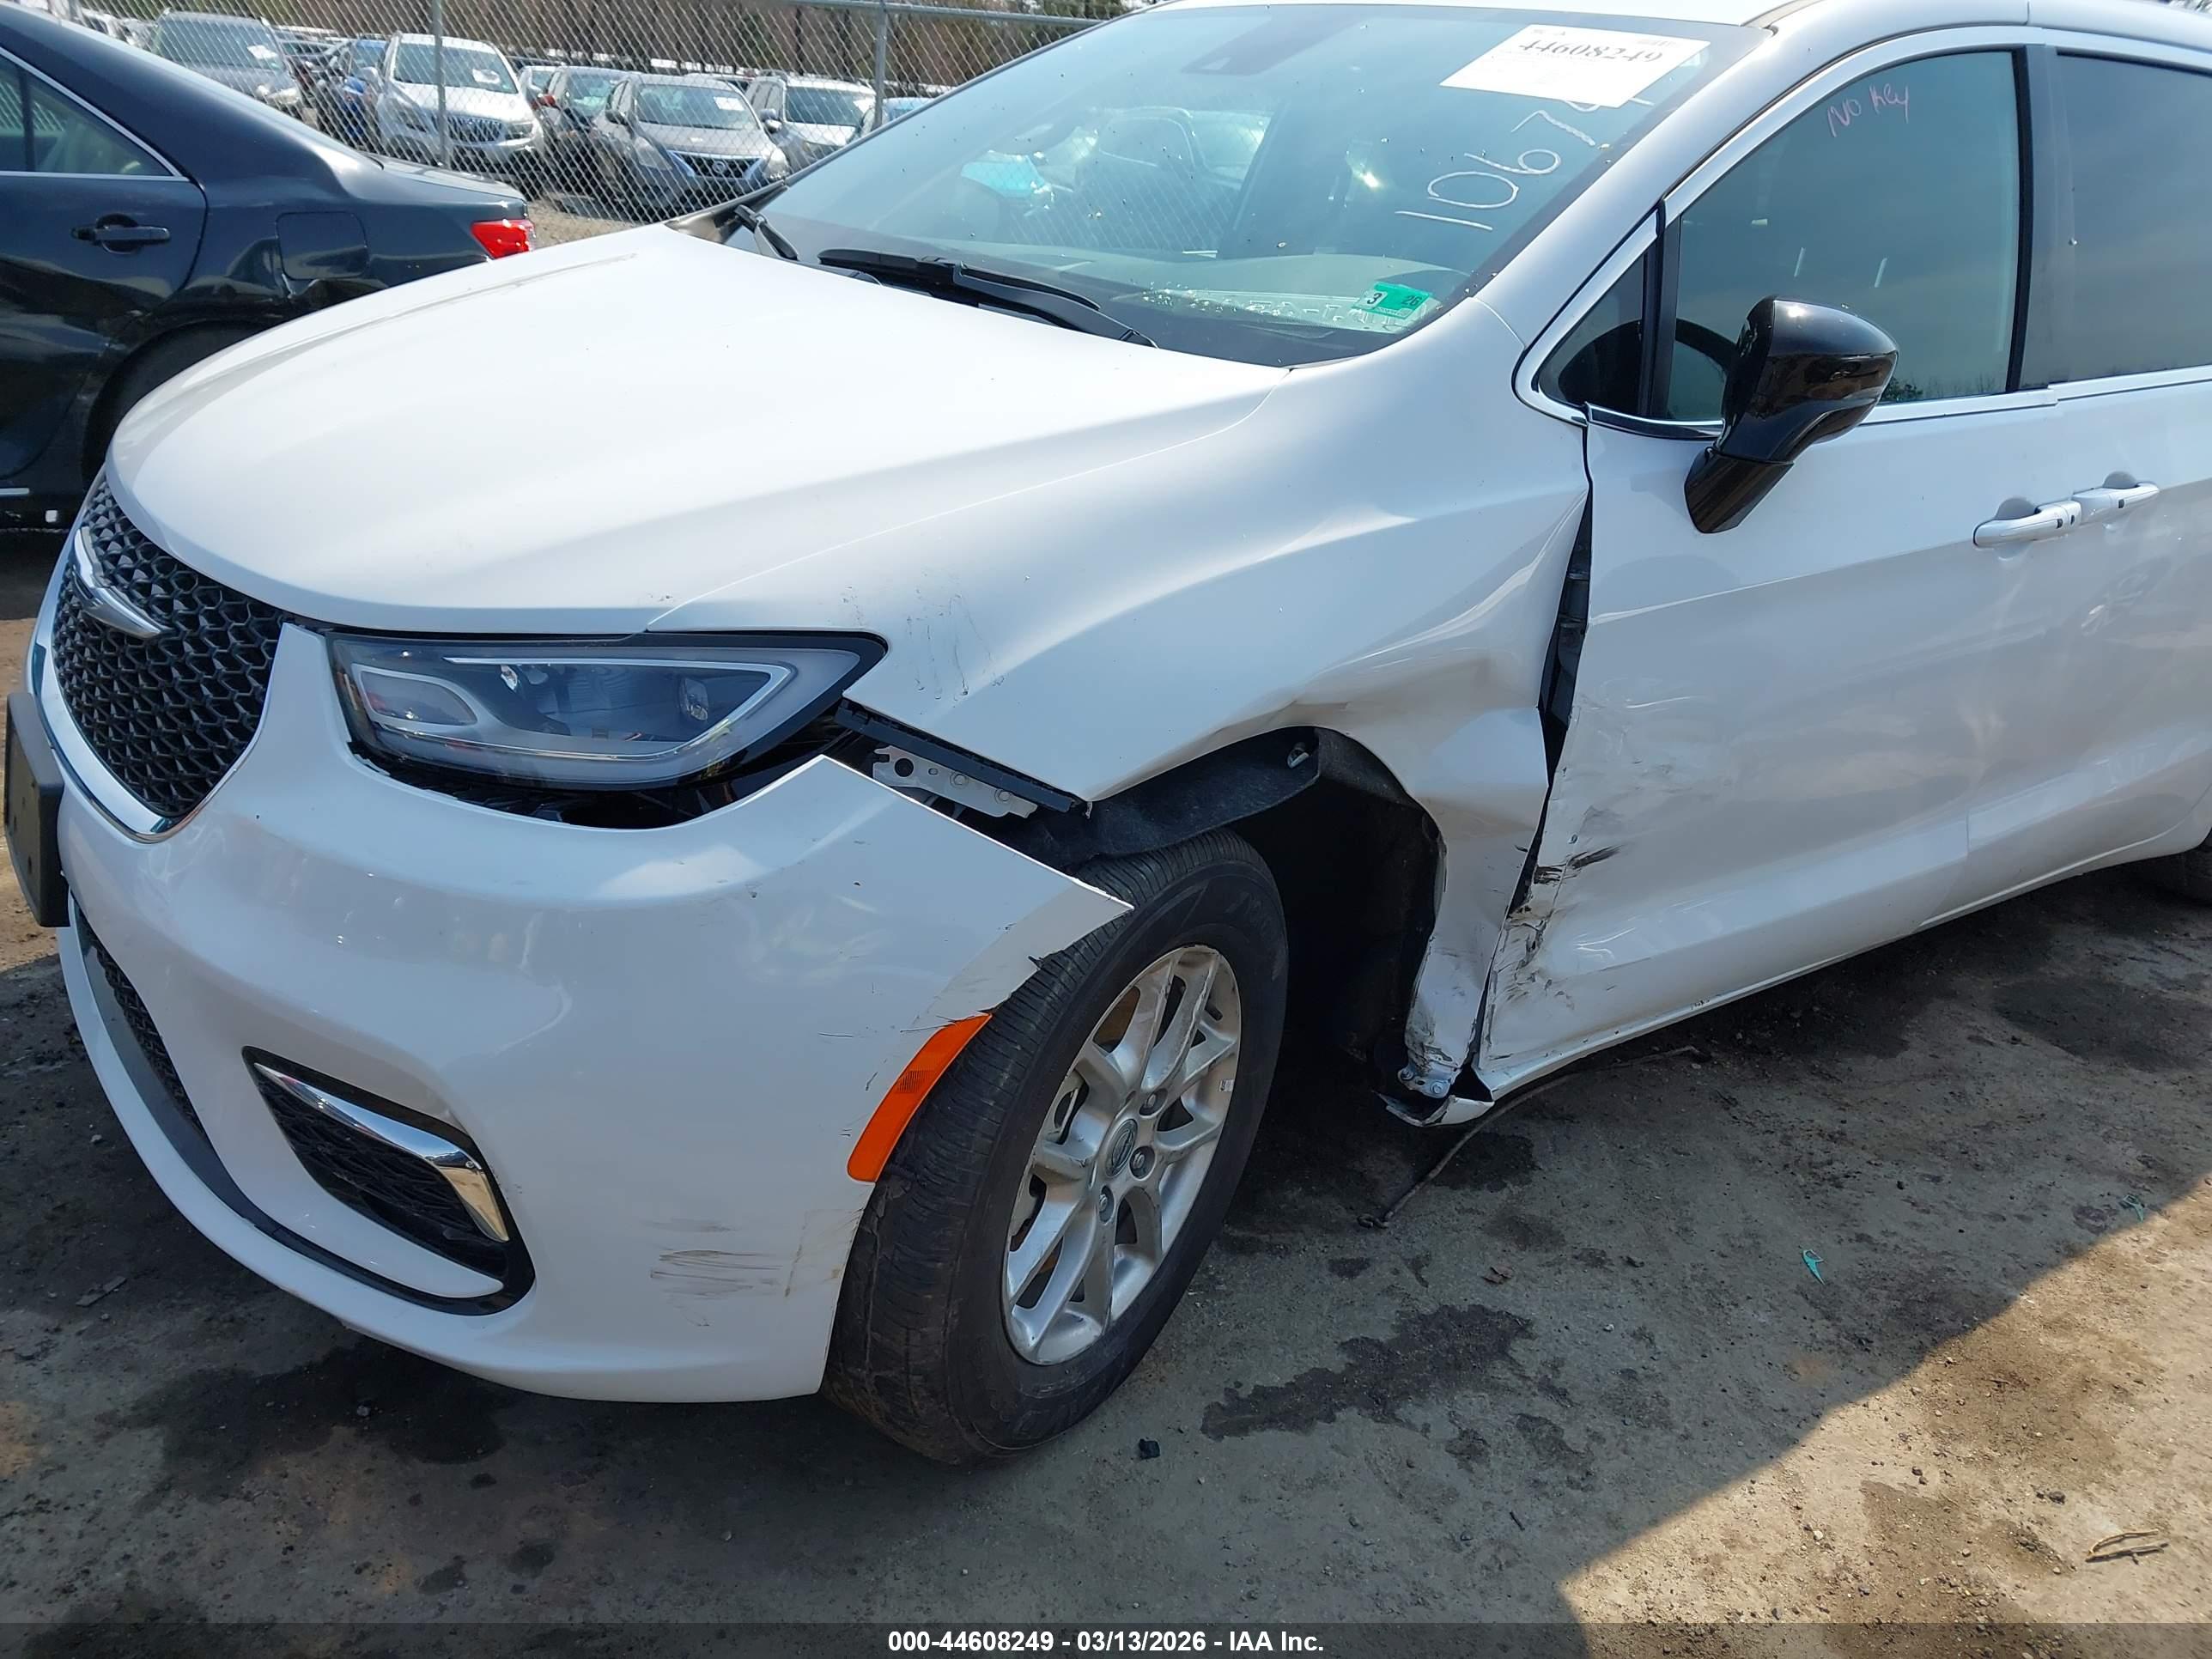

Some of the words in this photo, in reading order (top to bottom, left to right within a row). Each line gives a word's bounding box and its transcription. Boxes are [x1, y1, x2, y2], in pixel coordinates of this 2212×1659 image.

[1519, 40, 1662, 62] 44608249
[1366, 293, 1382, 304] 3
[1401, 295, 1423, 307] 26
